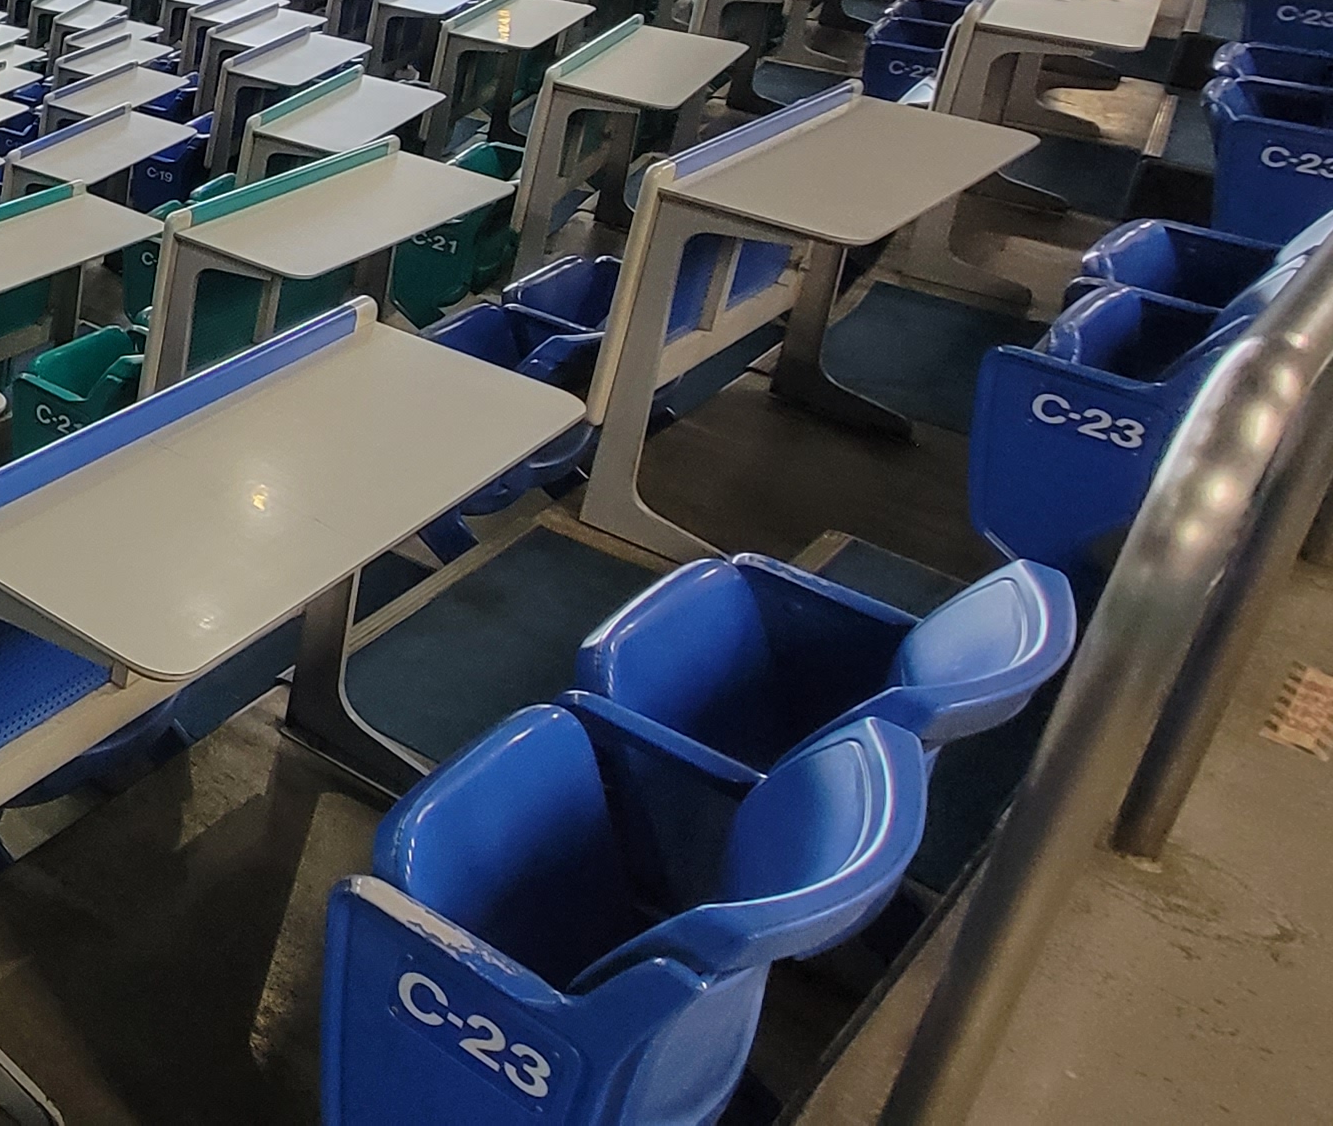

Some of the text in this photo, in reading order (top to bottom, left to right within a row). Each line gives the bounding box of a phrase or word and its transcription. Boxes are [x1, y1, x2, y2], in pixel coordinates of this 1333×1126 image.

[146, 166, 173, 183] C-19
[1030, 391, 1145, 450] C-23
[396, 969, 553, 1100] C-23
